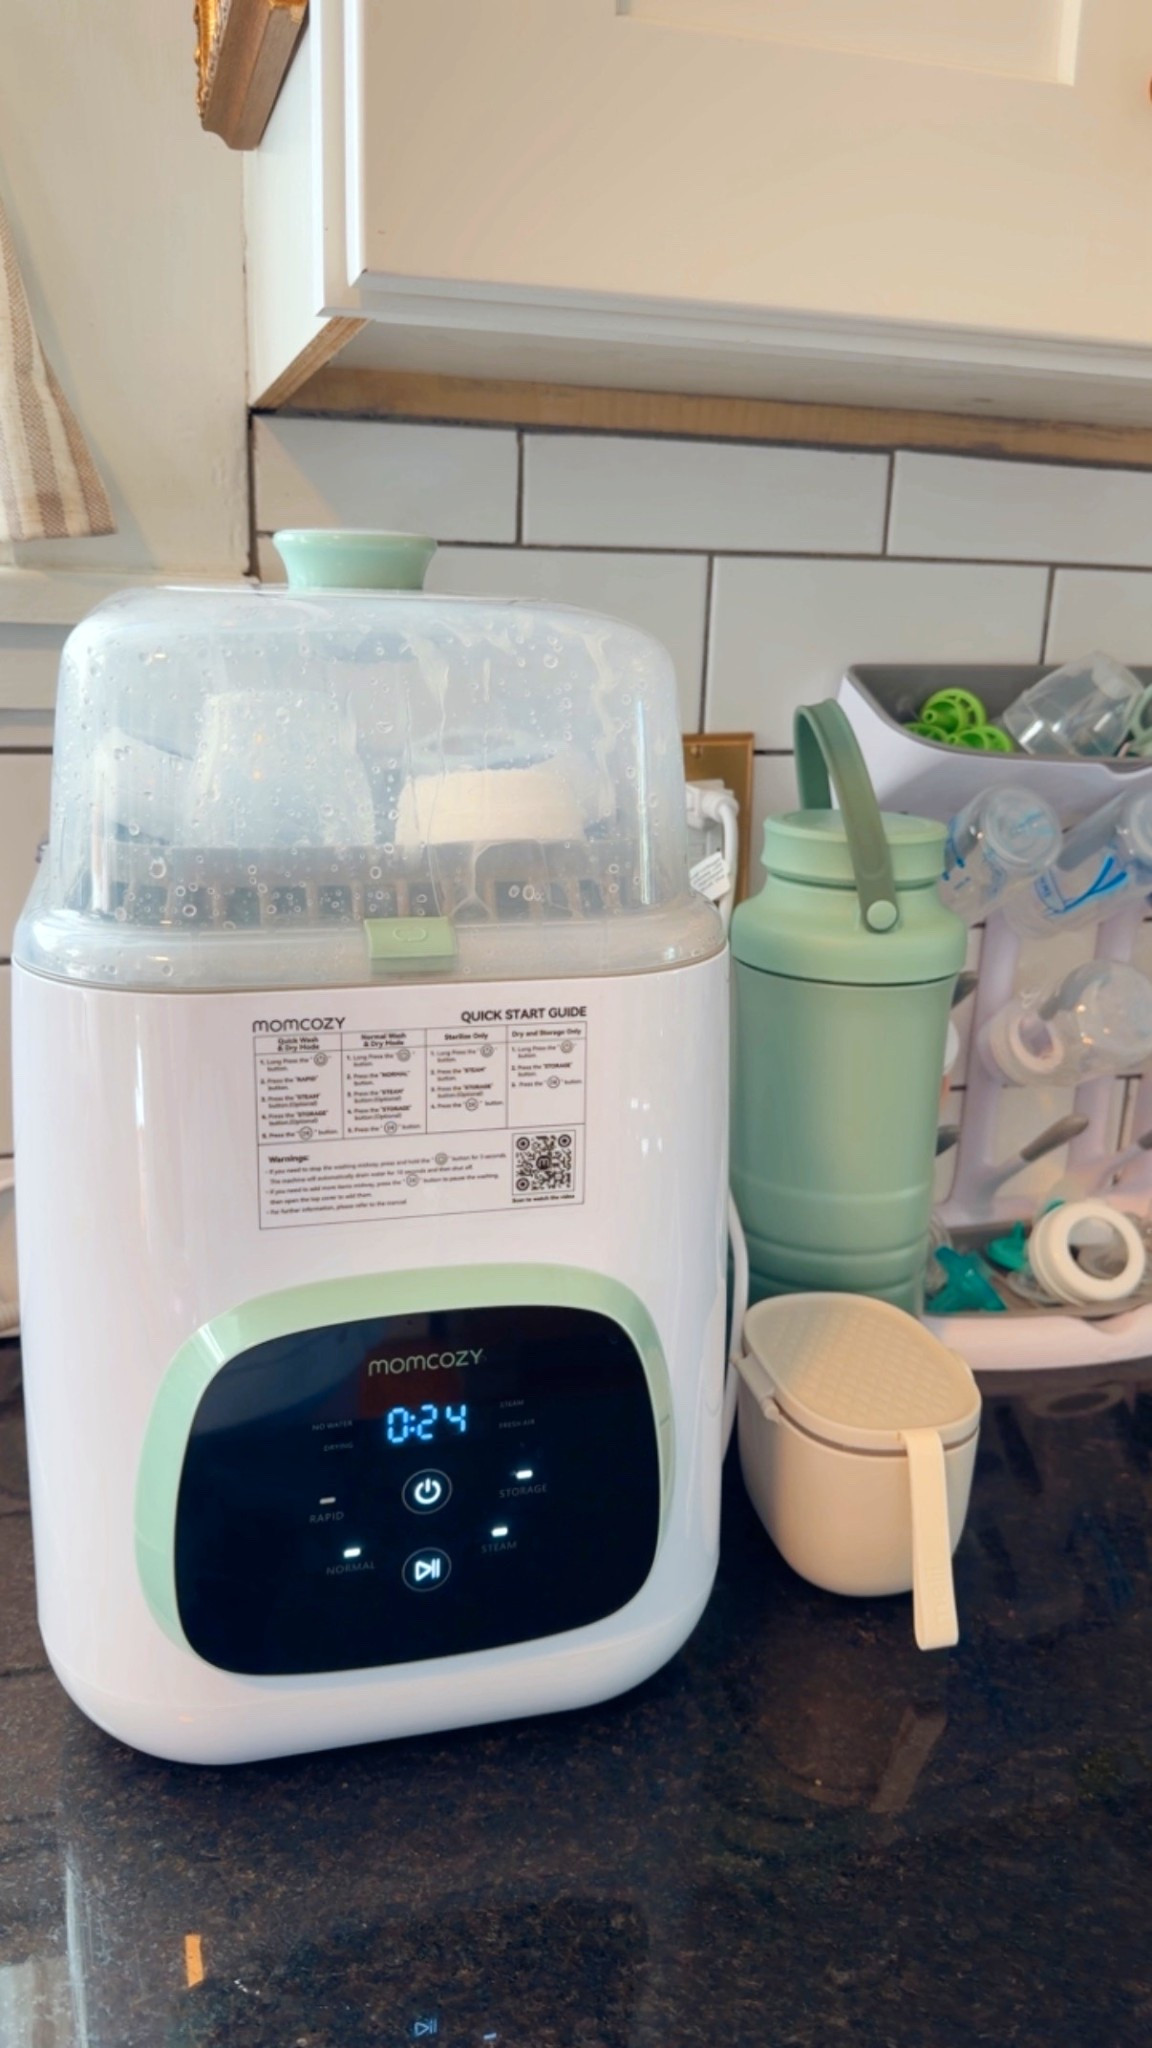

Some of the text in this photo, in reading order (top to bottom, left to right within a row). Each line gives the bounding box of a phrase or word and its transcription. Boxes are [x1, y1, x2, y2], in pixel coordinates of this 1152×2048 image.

[461, 1006, 588, 1024] QUICK START GUIDE
[387, 1404, 467, 1443] 0:24
[498, 1483, 548, 1498] STORAGE
[309, 1511, 345, 1524] RAPID
[481, 1541, 518, 1554] STEAM
[326, 1561, 376, 1576] NORMAL
